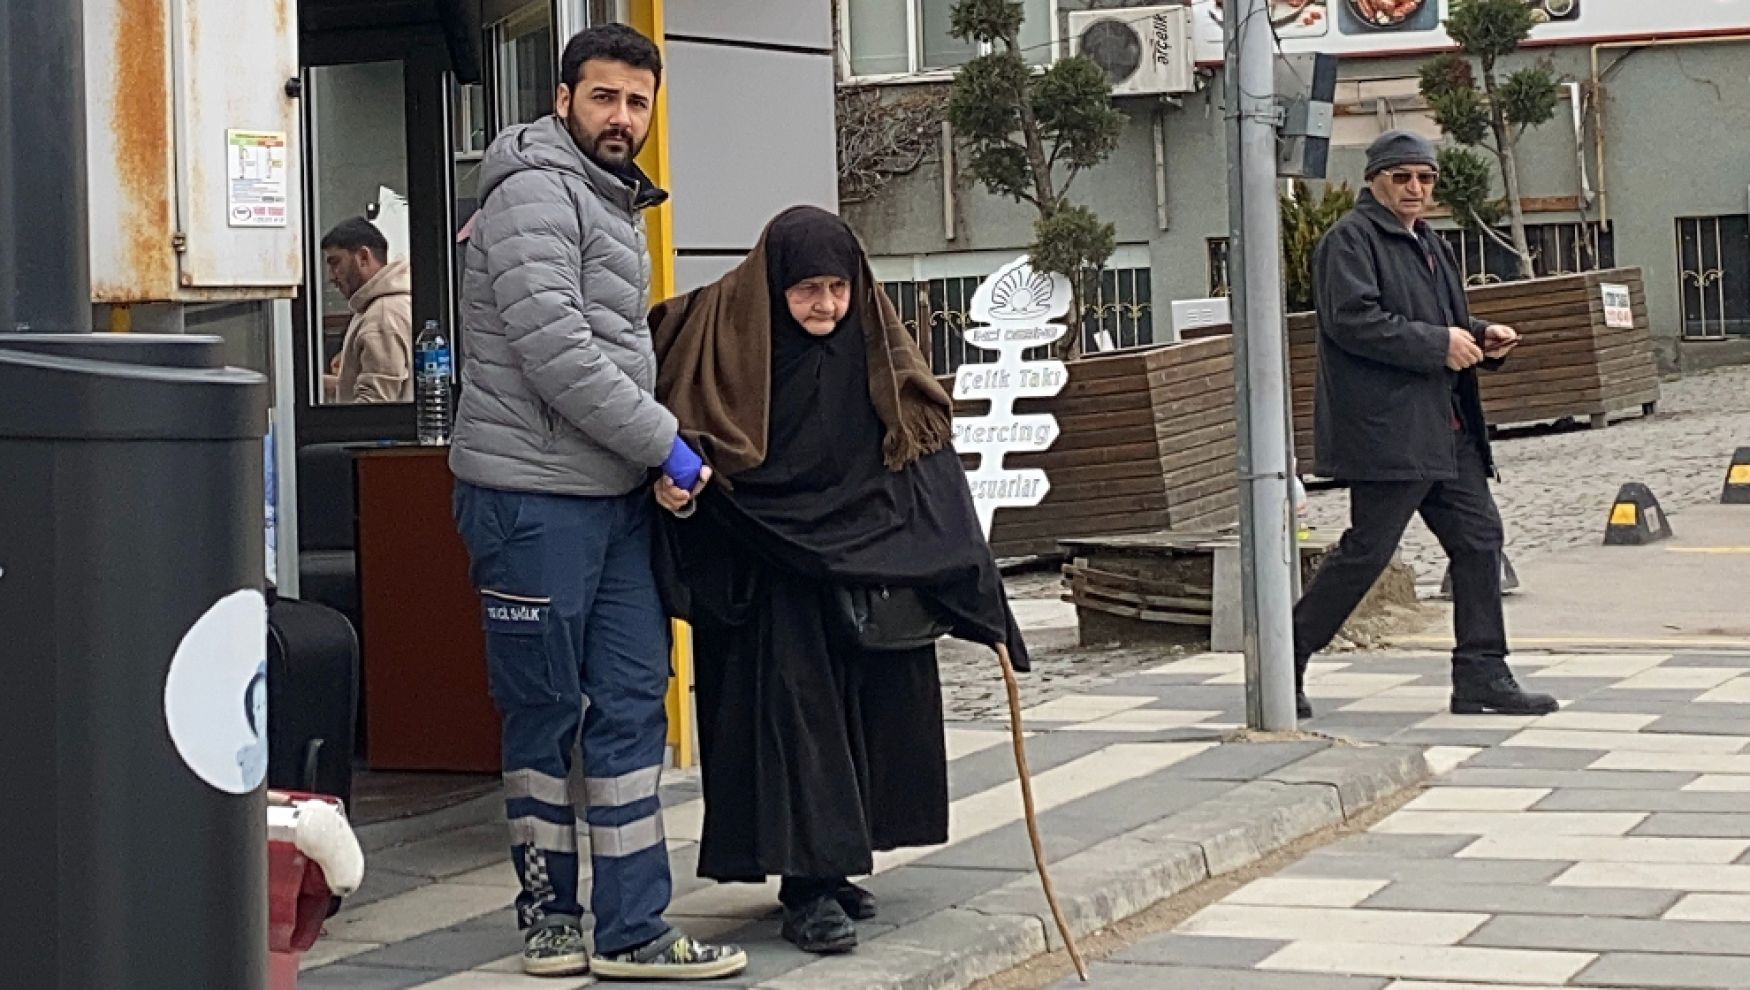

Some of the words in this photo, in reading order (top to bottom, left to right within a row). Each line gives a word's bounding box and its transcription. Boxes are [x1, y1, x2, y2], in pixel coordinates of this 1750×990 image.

[1152, 13, 1172, 65] arçelik
[960, 368, 1010, 394] Çelik
[1019, 367, 1061, 388] Takı
[968, 474, 1041, 499] esuarlar
